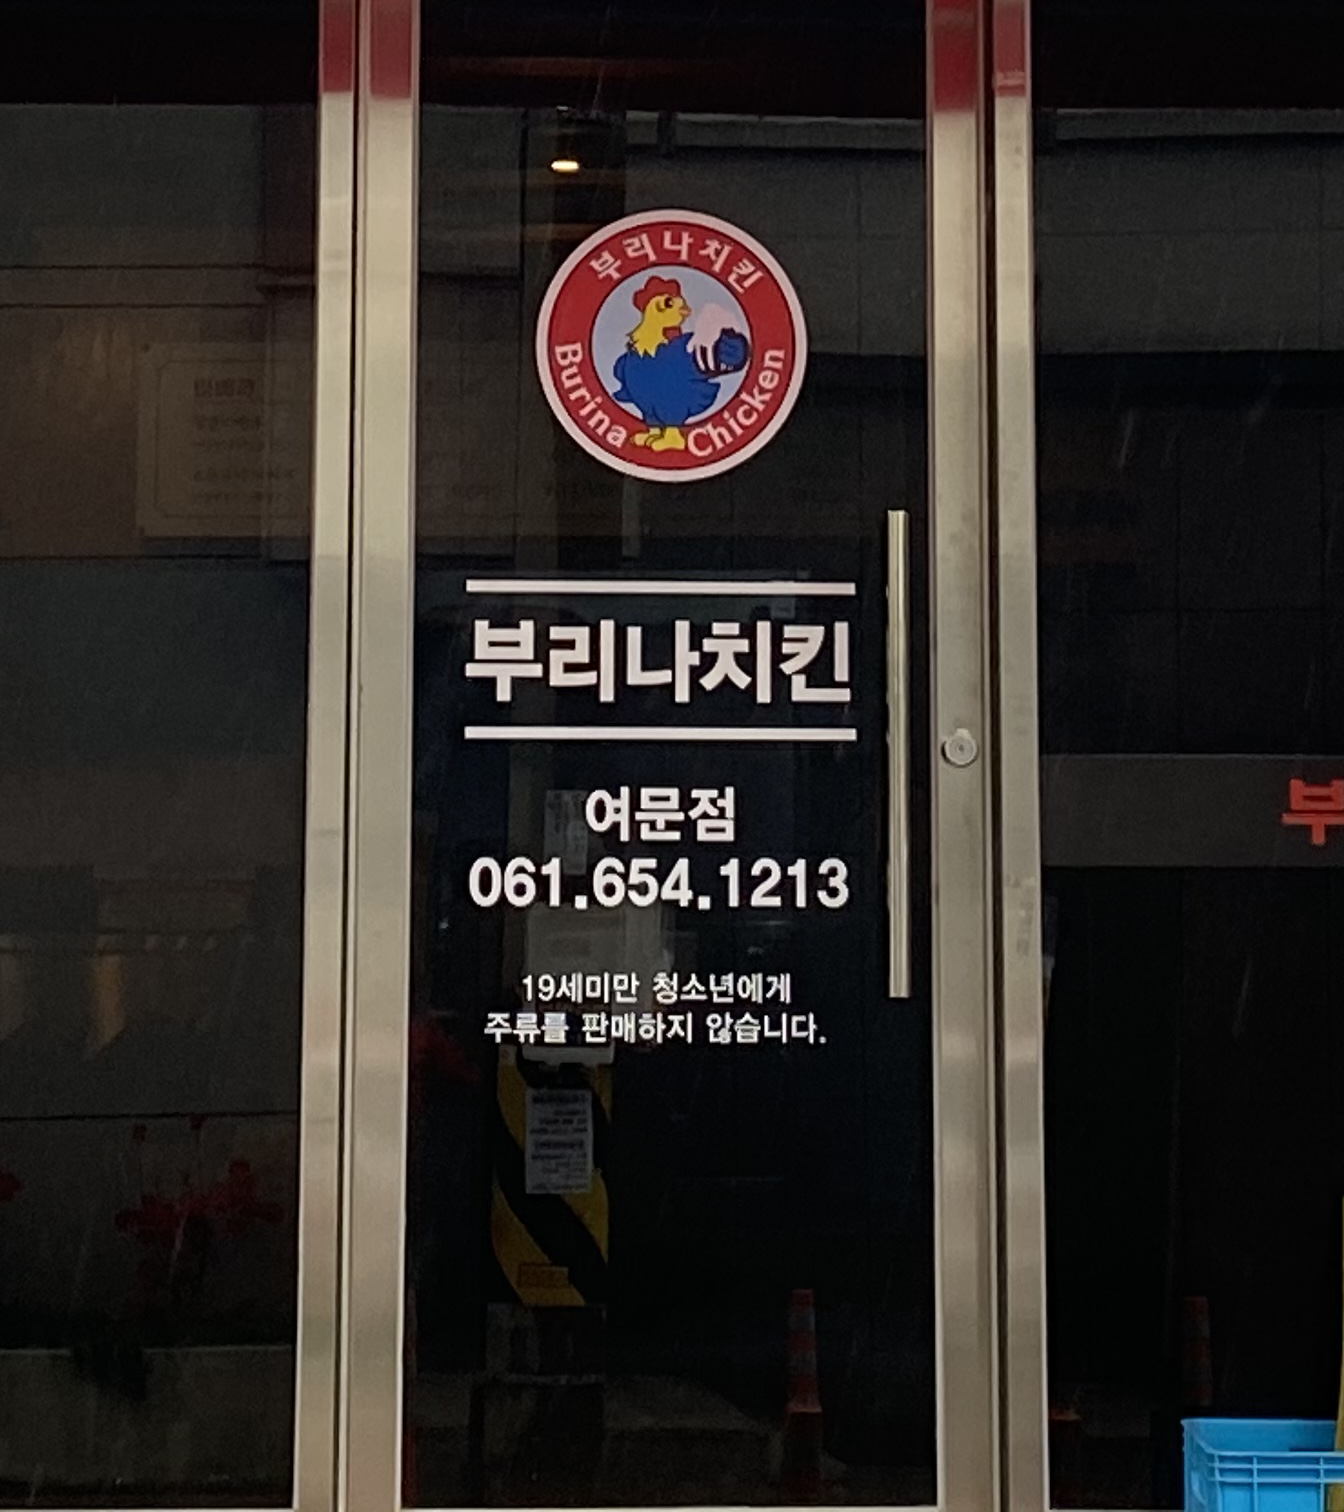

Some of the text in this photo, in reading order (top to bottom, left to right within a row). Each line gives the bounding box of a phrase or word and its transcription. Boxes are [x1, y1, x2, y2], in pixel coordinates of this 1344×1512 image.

[590, 230, 764, 294] 부리나치킨
[555, 341, 628, 448] Burina
[686, 348, 786, 457] Chicken
[464, 619, 852, 704] 부리나치킨
[584, 785, 736, 842] 여문점
[468, 856, 850, 910] 061.654.1213
[522, 971, 792, 1005] 19세미만 청소년에게
[483, 1011, 828, 1045] 주류를 판매하지 않습니다.
